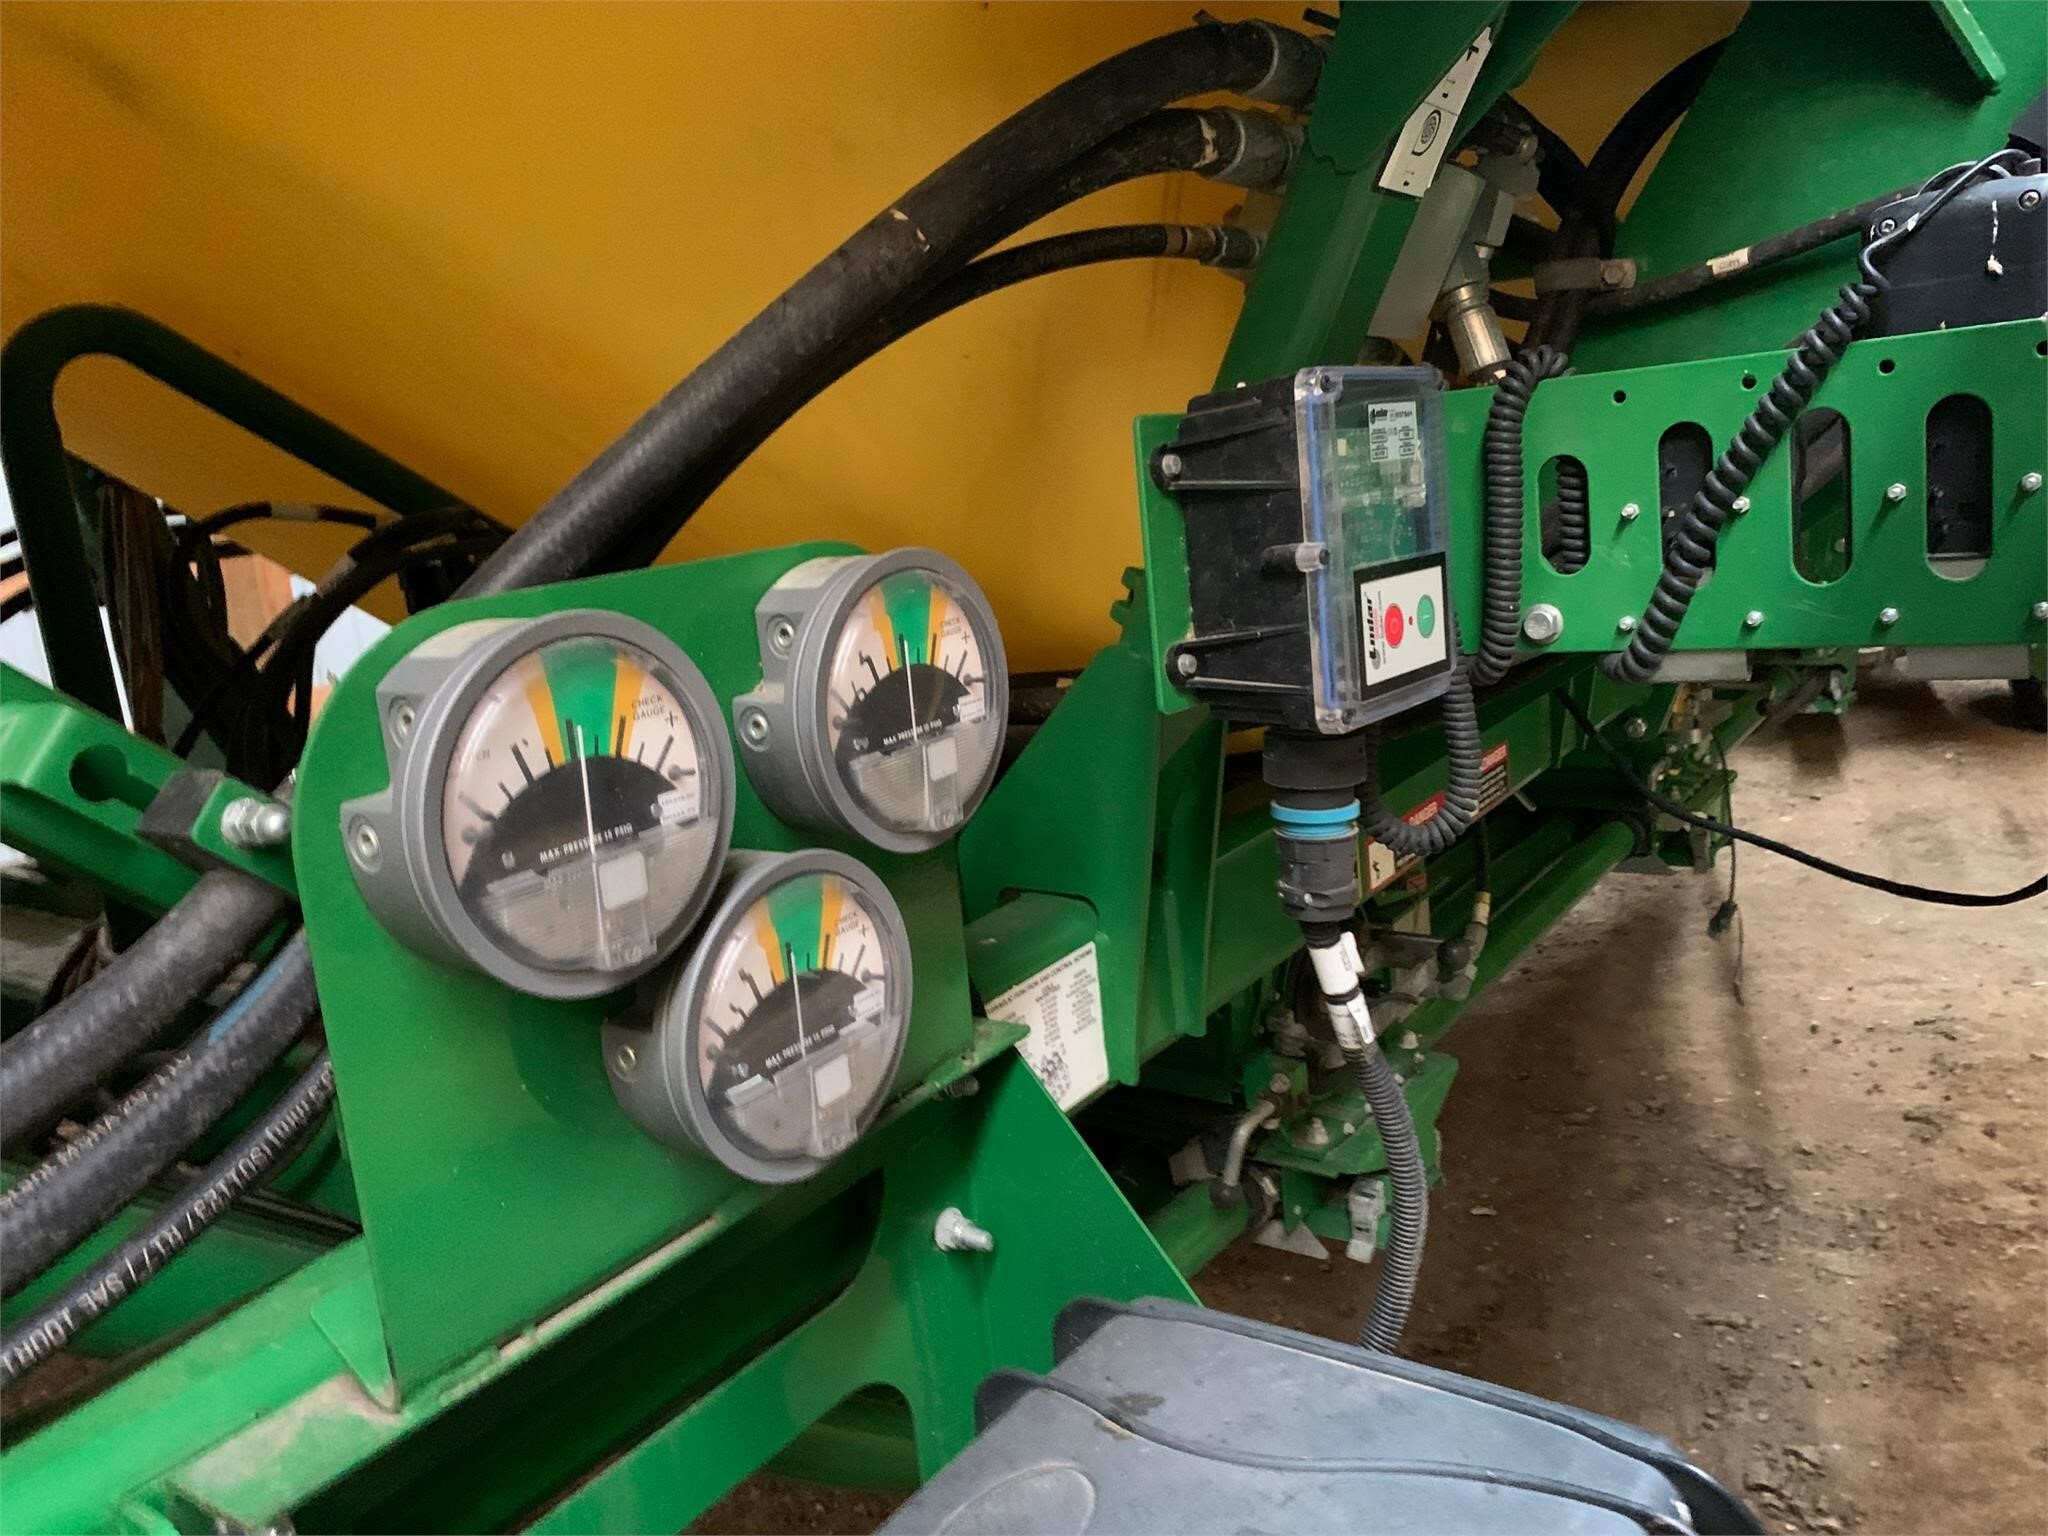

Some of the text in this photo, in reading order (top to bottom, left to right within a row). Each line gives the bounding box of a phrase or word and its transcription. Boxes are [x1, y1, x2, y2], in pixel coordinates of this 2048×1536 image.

[631, 693, 663, 710] CHECK
[632, 706, 664, 722] GAUGE
[563, 832, 603, 855] PRESSURE
[78, 1272, 126, 1314] SAE
